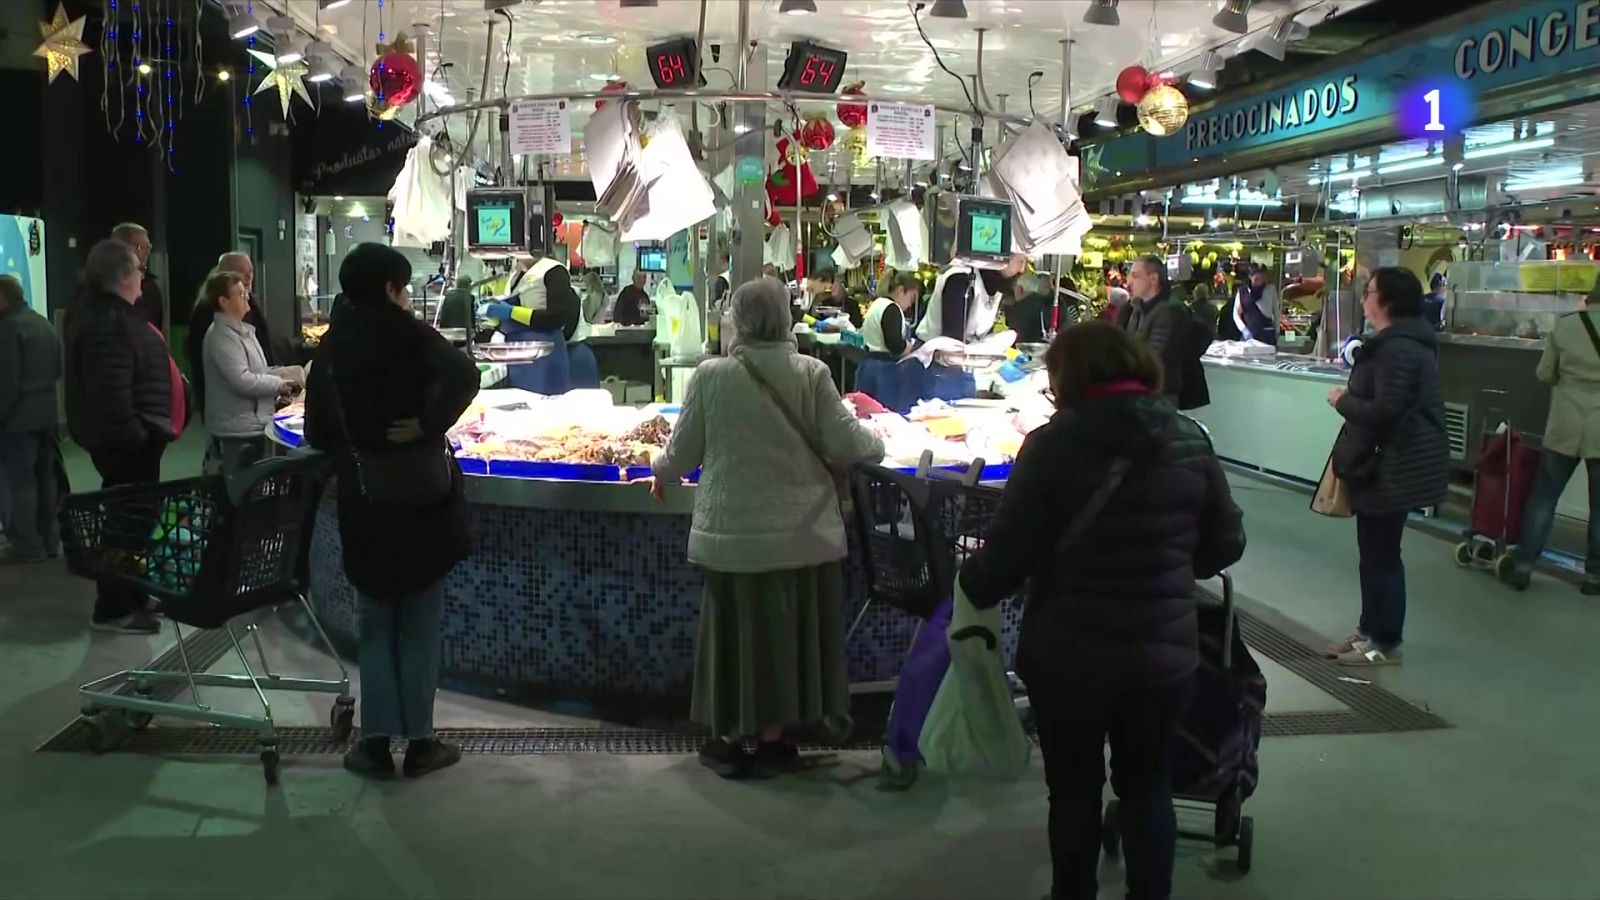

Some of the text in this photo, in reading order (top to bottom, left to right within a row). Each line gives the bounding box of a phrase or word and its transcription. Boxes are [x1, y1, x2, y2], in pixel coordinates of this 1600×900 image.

[1454, 0, 1600, 80] CONGE
[657, 55, 685, 83] 64
[801, 54, 836, 86] 64
[1186, 74, 1358, 151] PRECOCINADOS
